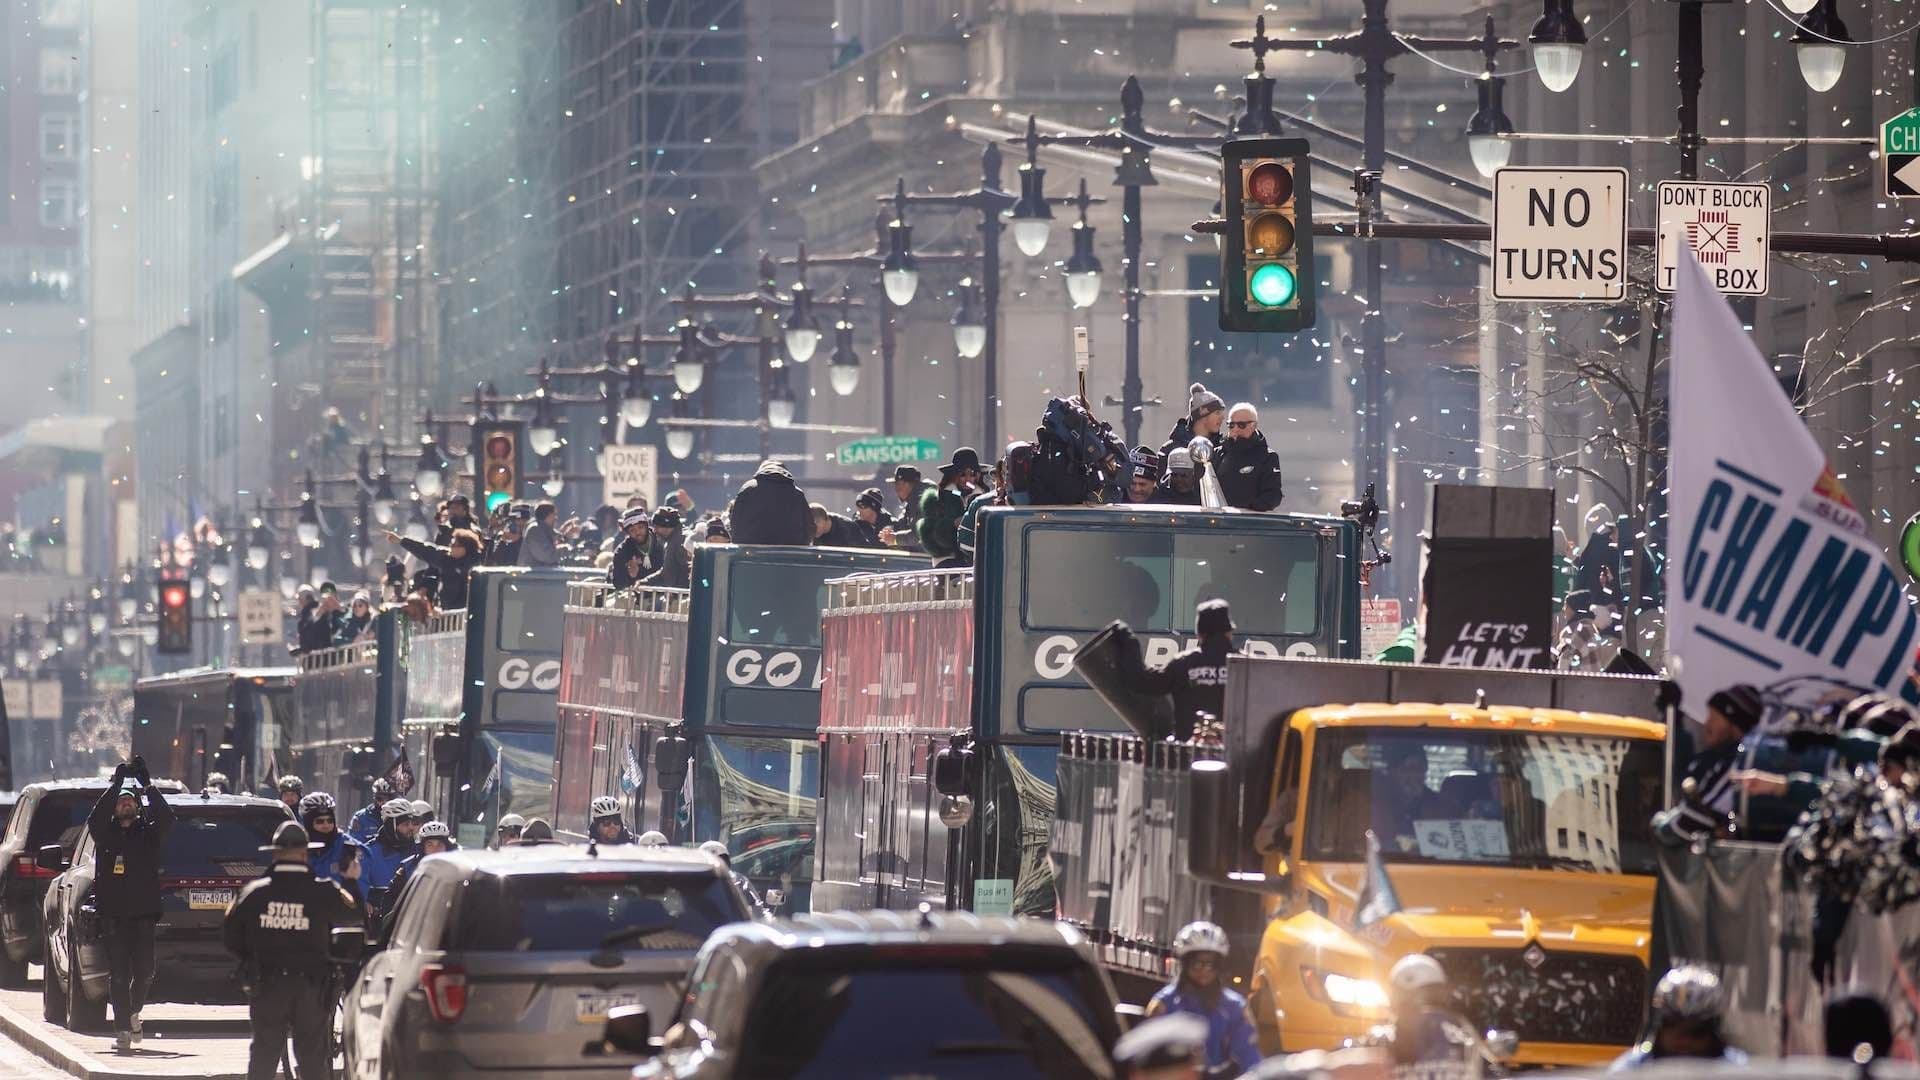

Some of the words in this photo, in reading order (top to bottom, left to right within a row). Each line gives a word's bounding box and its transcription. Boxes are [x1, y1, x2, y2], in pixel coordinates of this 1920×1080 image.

[1890, 126, 1920, 151] CH
[1529, 188, 1590, 227] NO
[1664, 187, 1706, 206] DON'T
[1713, 189, 1763, 208] BLOCK
[1500, 248, 1618, 280] TURNS
[1716, 268, 1758, 289] BOX
[612, 452, 649, 467] ONE
[842, 446, 918, 462] SANSOM
[612, 470, 648, 483] WAY
[1683, 478, 1920, 706] CHAMPI
[1458, 622, 1529, 643] LET'S
[498, 658, 561, 690] GO
[726, 649, 802, 687] GO
[1188, 667, 1217, 680] SPFX
[267, 901, 304, 917] STATE
[259, 914, 310, 930] TROOPER
